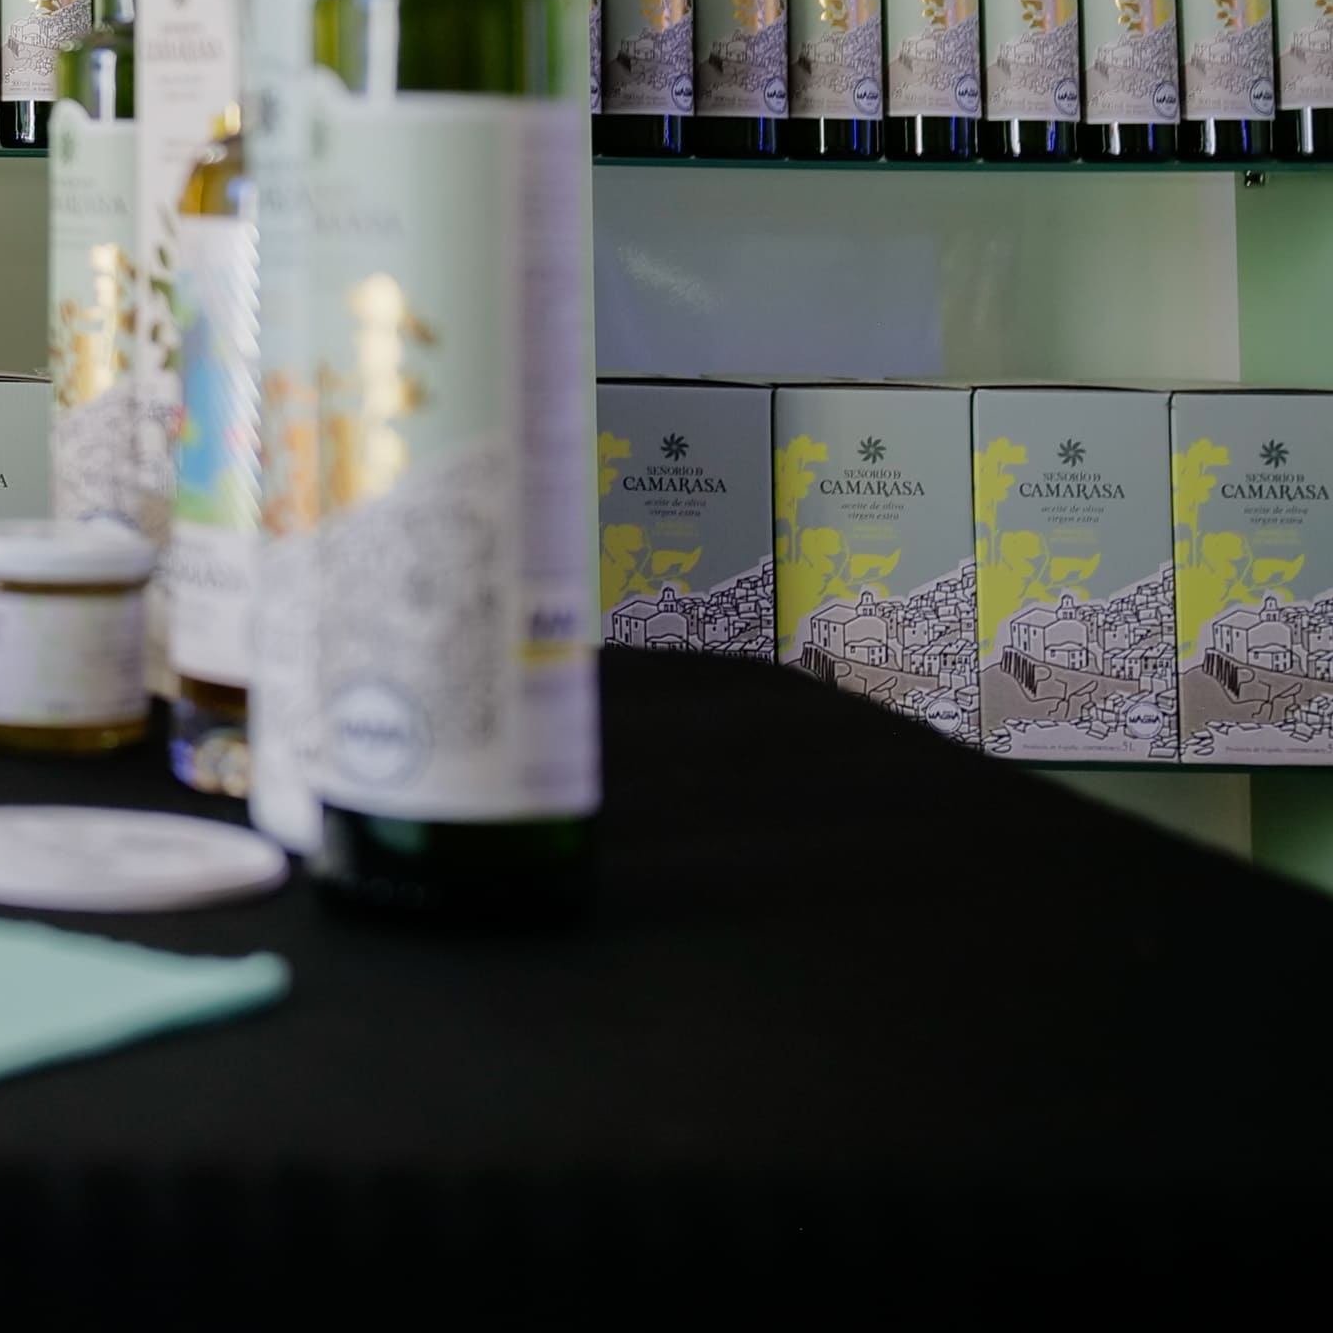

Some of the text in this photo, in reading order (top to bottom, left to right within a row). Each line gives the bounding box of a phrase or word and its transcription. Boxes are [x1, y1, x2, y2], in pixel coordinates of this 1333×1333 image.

[622, 476, 727, 495] CAMARASA
[820, 480, 924, 497] CAMARASA
[1019, 483, 1125, 500] CAMARASA
[1221, 484, 1329, 501] CAMARASA
[672, 499, 682, 507] de
[685, 499, 706, 507] oliva
[869, 502, 880, 510] de
[883, 502, 904, 510] oliva
[678, 509, 701, 517] extra
